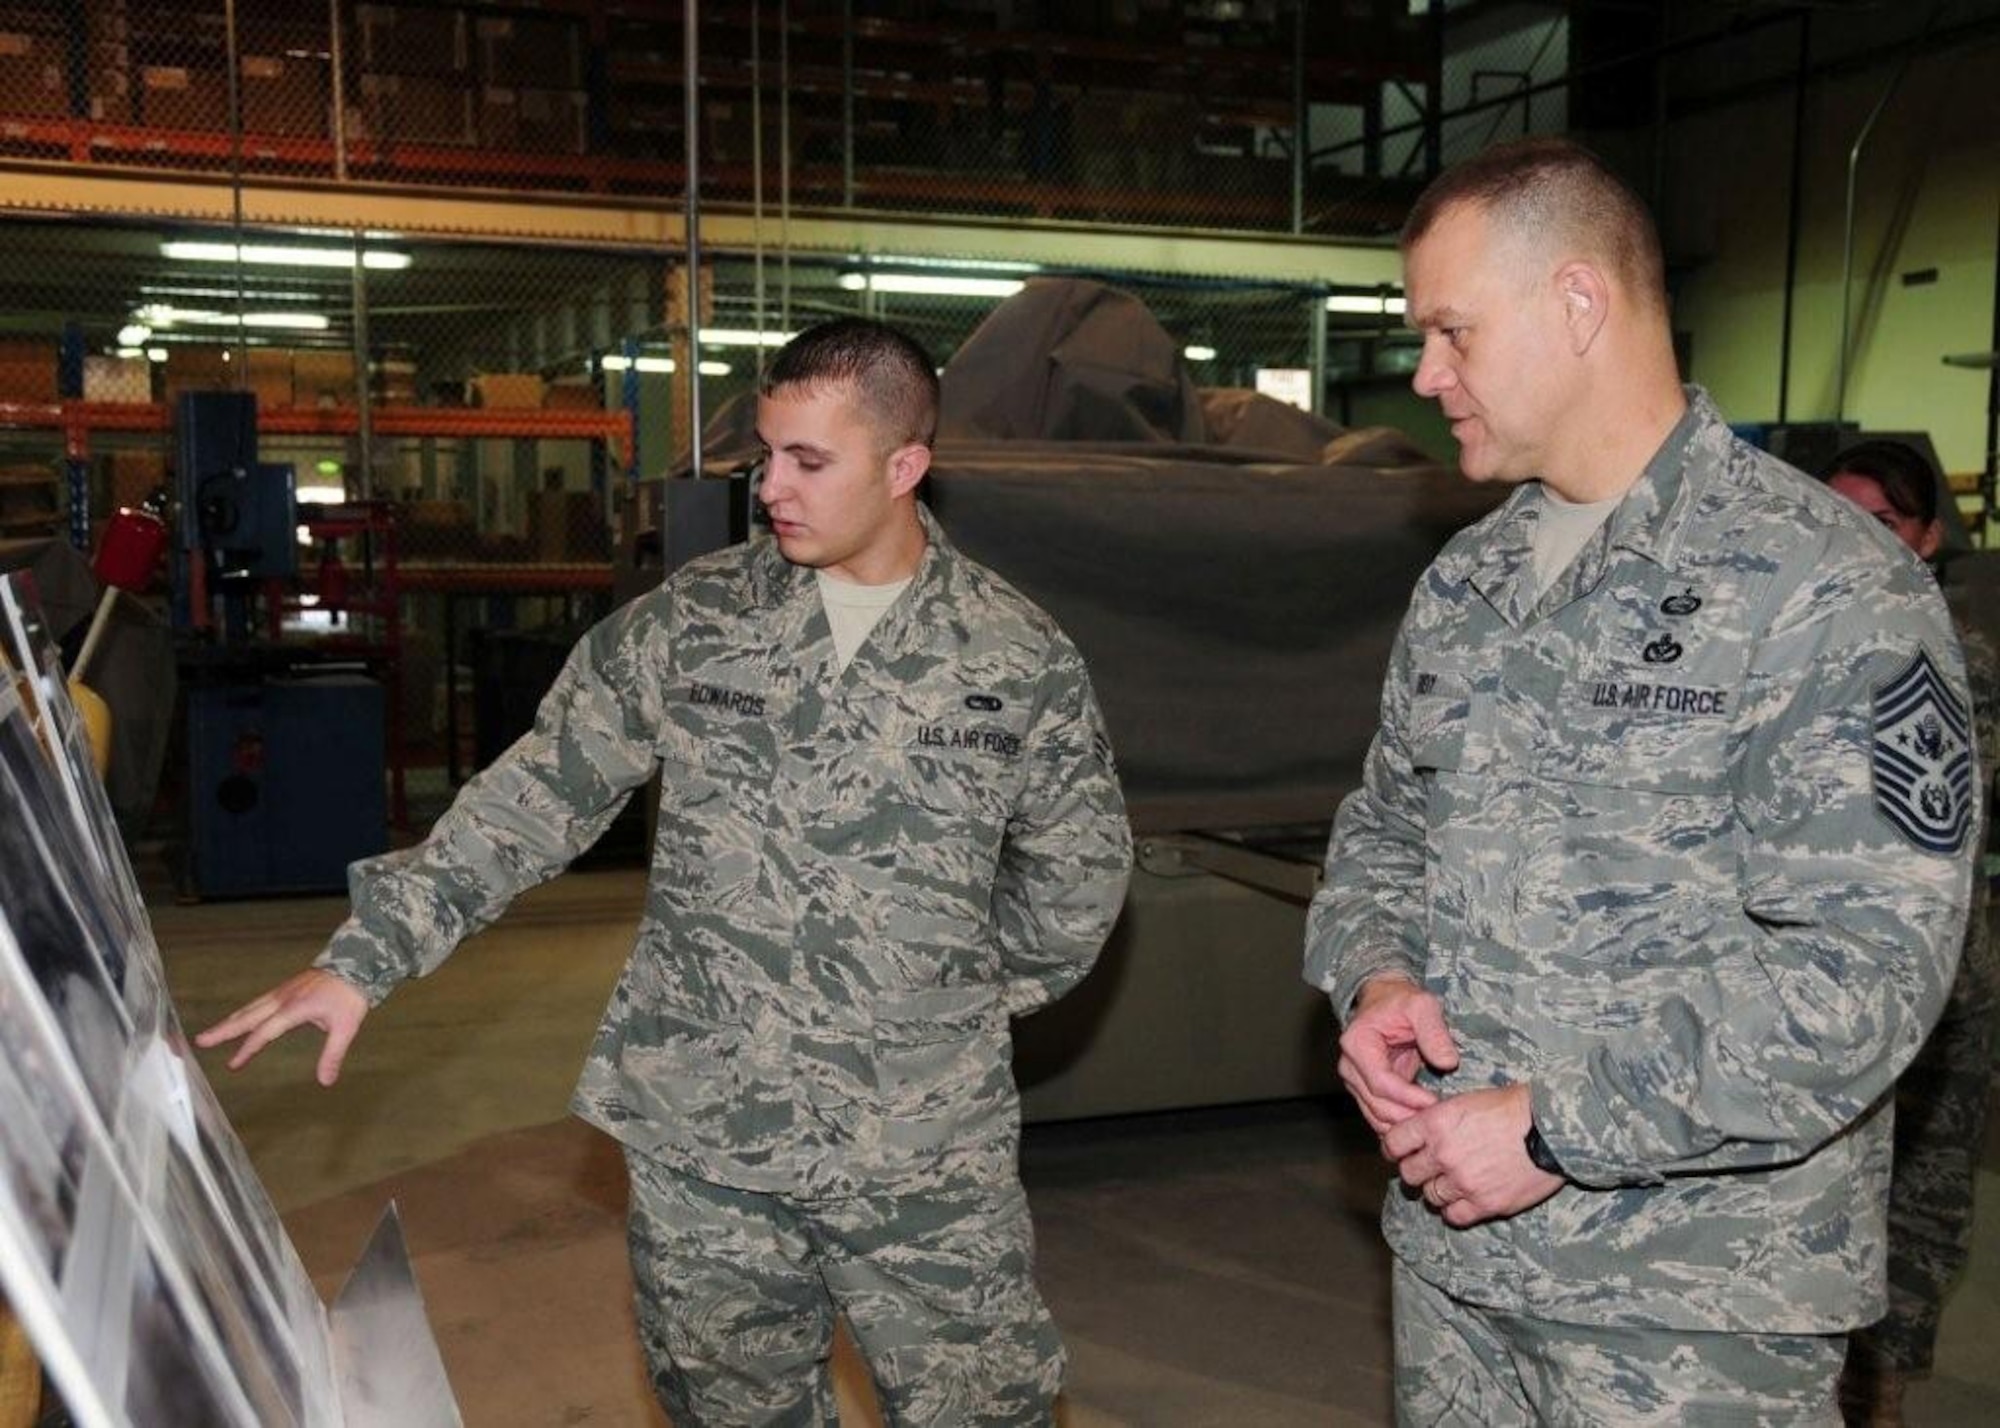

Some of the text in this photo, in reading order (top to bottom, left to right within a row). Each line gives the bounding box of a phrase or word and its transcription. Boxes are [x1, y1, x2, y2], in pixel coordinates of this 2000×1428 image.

[690, 683, 766, 716] EDWARDS
[1593, 683, 1727, 714] U.S. AIR FORCE
[951, 728, 979, 750] AIR
